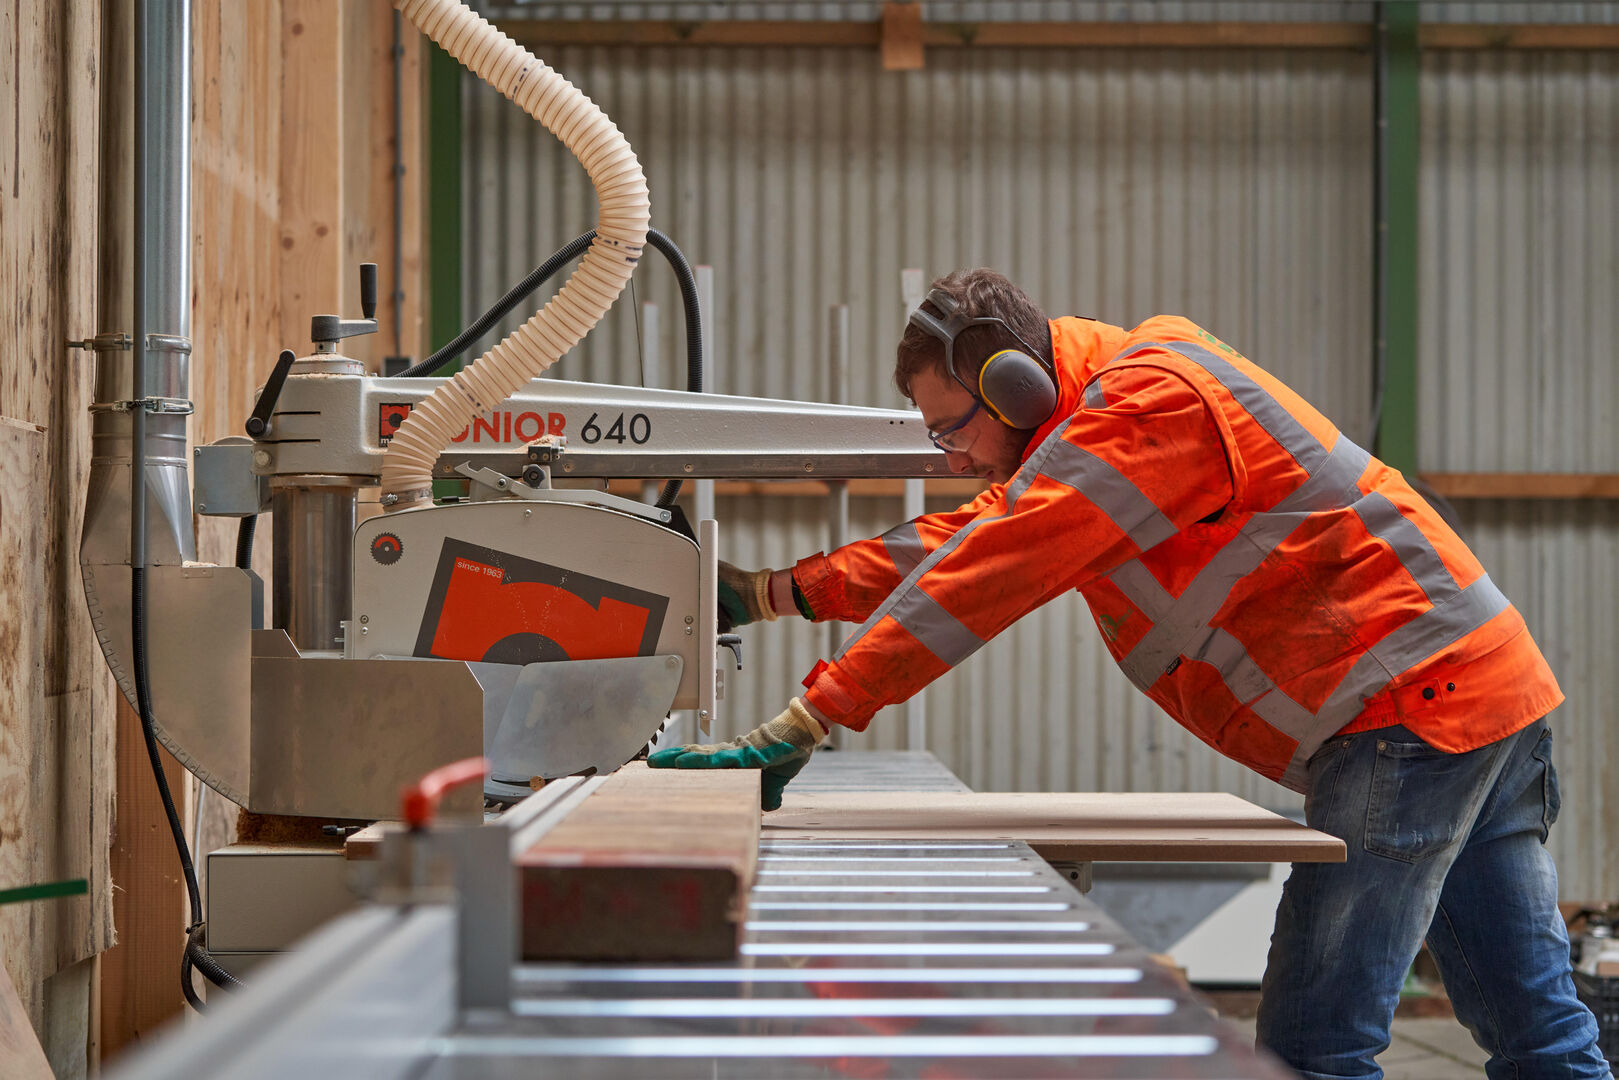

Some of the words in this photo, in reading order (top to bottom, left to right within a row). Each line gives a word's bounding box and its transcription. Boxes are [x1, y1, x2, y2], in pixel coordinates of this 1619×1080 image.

[581, 412, 651, 444] 640
[457, 561, 480, 572] since
[483, 567, 502, 578] 1963
